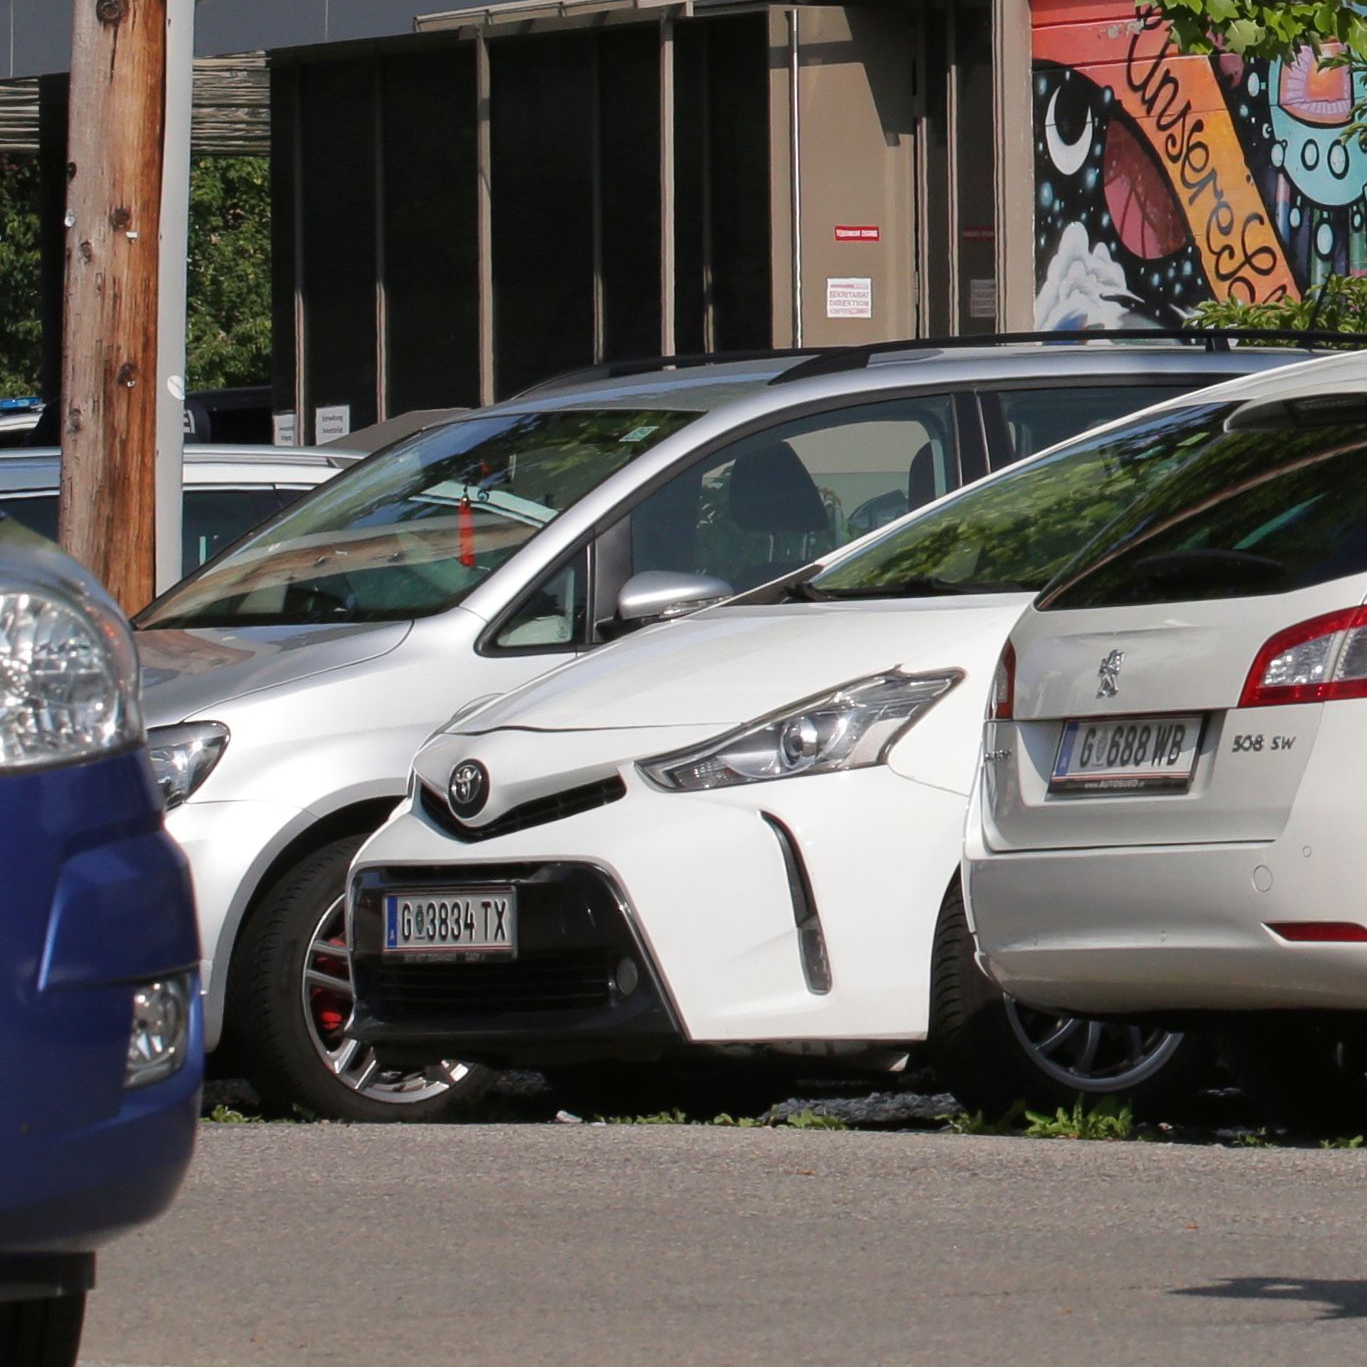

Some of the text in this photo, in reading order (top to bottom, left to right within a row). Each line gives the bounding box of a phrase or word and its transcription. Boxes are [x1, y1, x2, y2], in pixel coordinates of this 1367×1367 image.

[1080, 724, 1187, 768] G 688 WB
[1231, 734, 1296, 753] 508 SW
[402, 900, 507, 942] G 3834 TX
